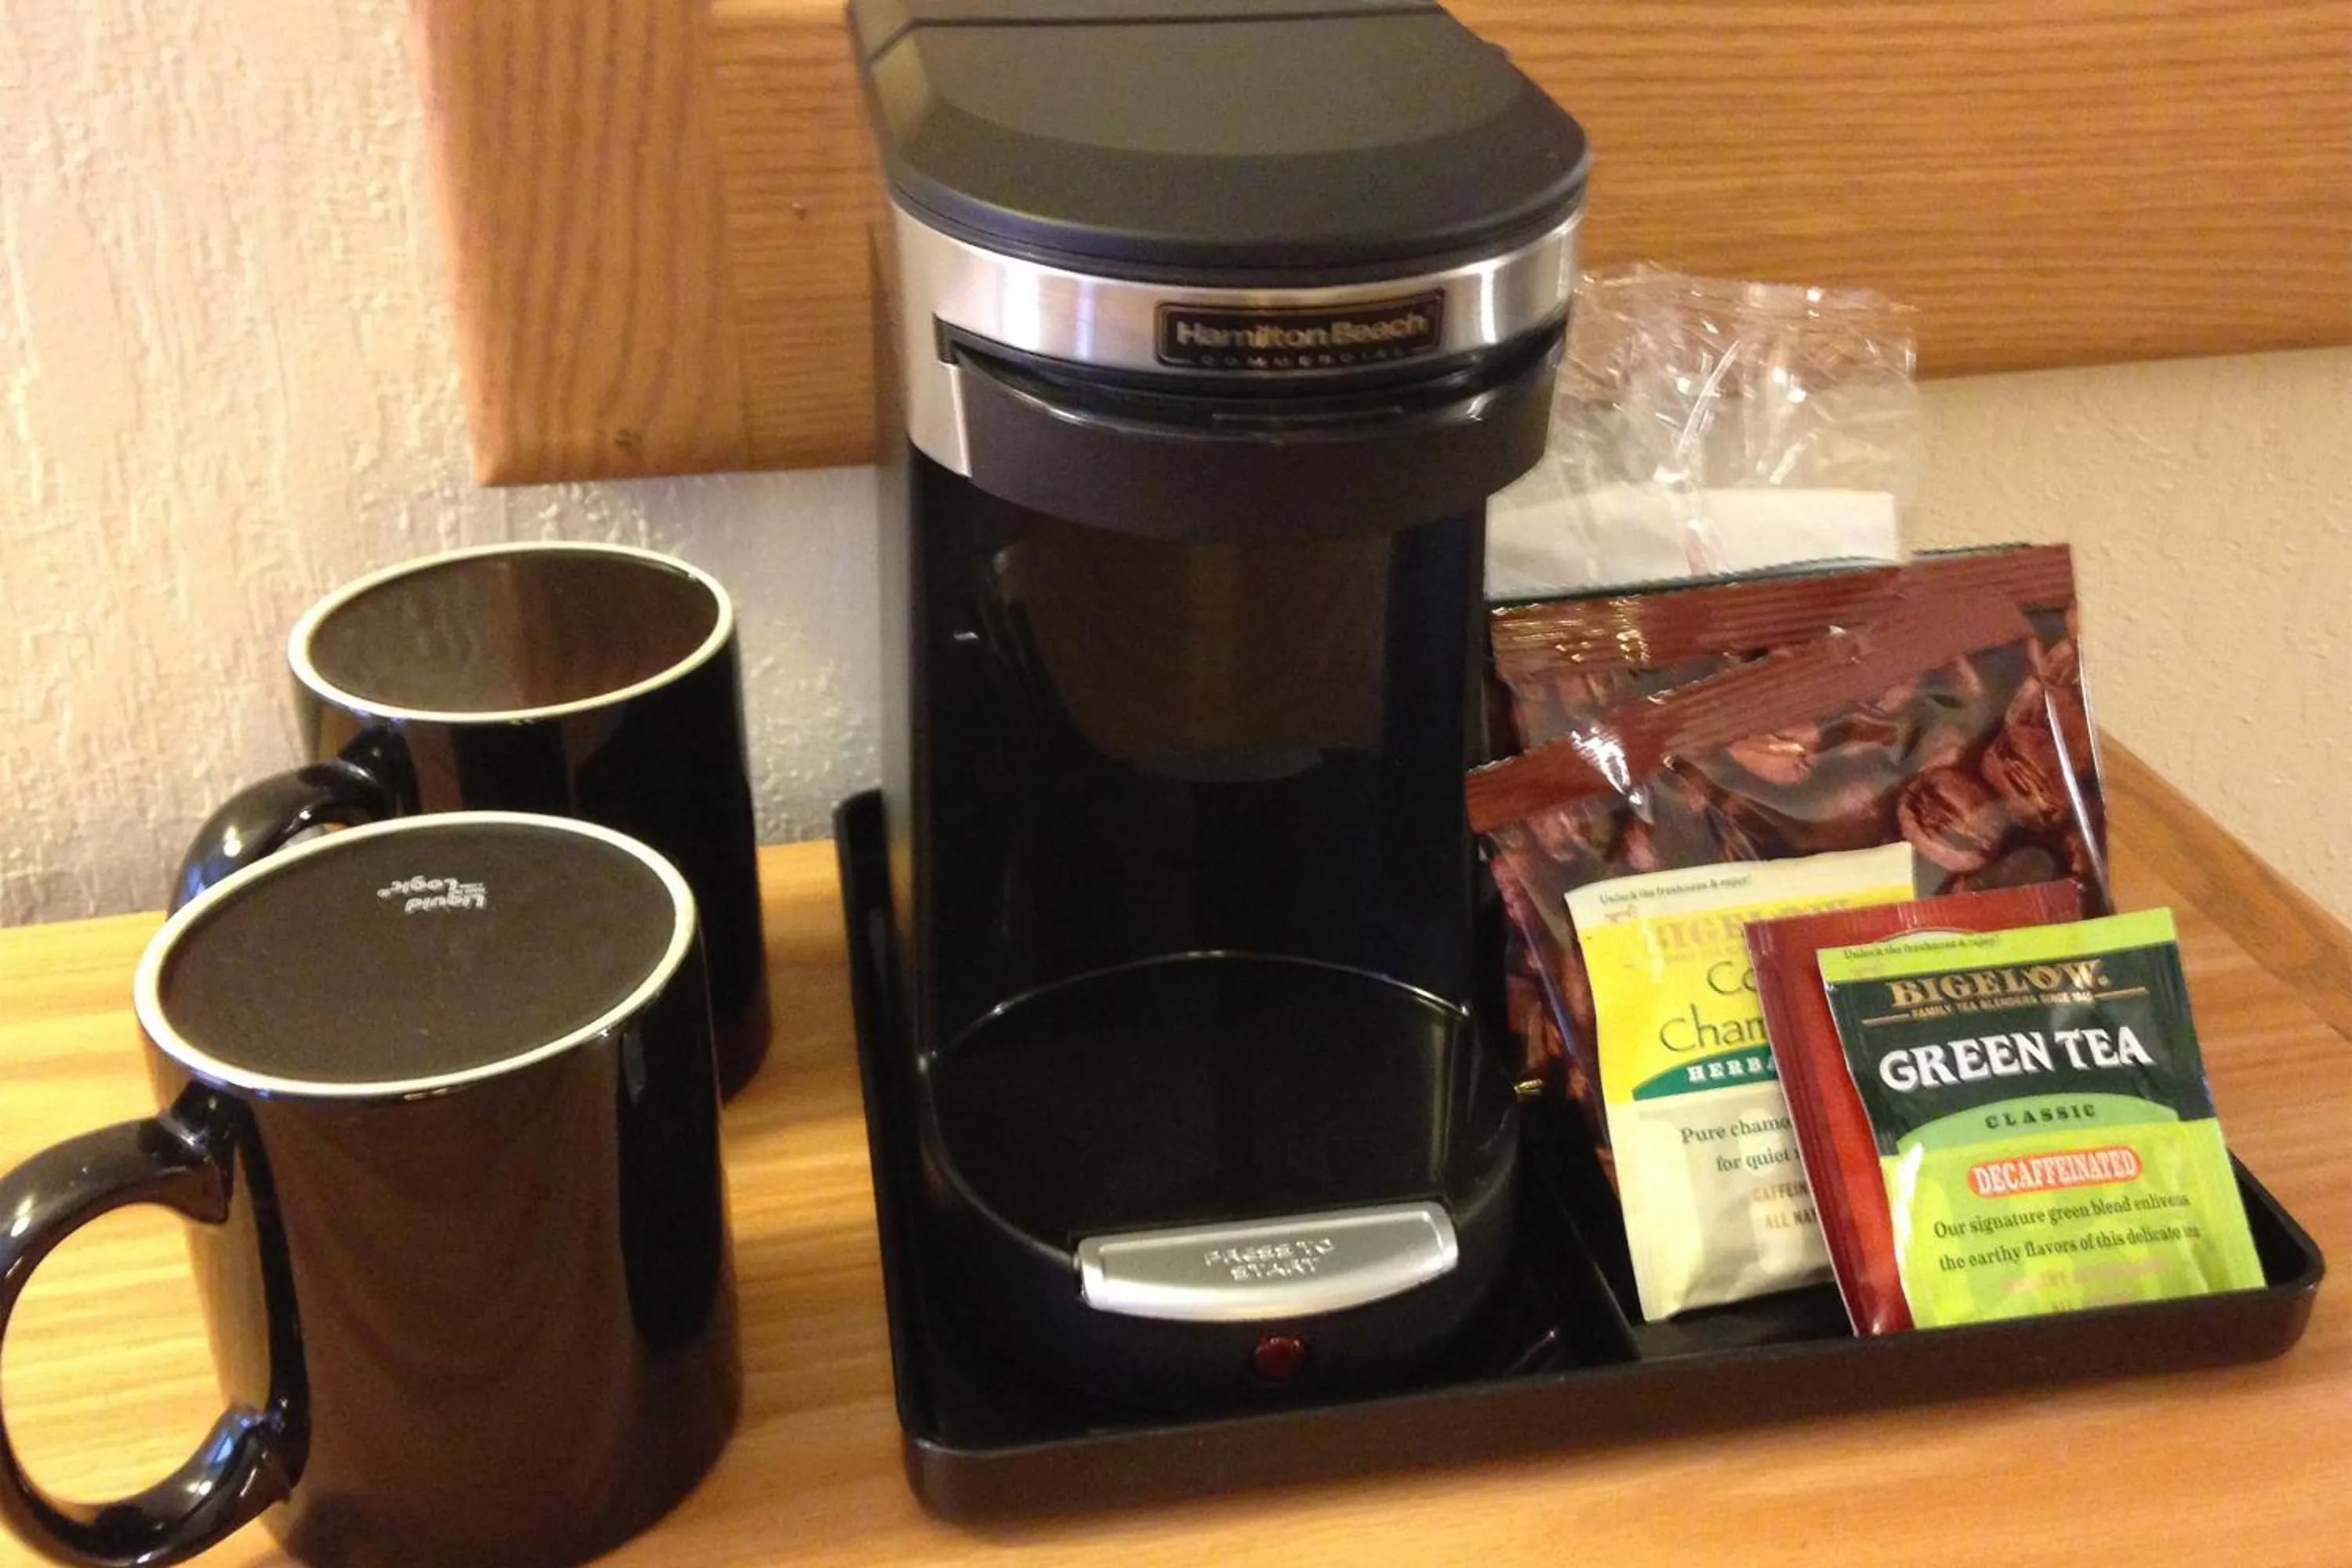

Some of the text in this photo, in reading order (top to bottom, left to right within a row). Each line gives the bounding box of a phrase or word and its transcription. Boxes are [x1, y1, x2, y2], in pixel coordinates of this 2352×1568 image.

[1177, 312, 1430, 349] Hamilton Beach
[390, 875, 459, 895] Logic
[404, 892, 487, 915] Liquid
[1706, 960, 1757, 996] Co
[1886, 958, 2106, 1009] BIGELOW
[1659, 1003, 1766, 1052] Cham
[1879, 1025, 2158, 1094] GREEN TEA
[1680, 1116, 1793, 1145] Pure chamo
[1984, 1103, 2096, 1130] CLASSIC
[1715, 1154, 1742, 1172] for
[1746, 1146, 1791, 1171] quiet
[1973, 1149, 2138, 1196] DECAFFEINATED
[1751, 1179, 1809, 1203] CAFFEIN
[1765, 1213, 1791, 1230] ALL
[1933, 1221, 1969, 1239] Our
[1969, 1207, 2045, 1236] signature
[2046, 1203, 2091, 1226] green
[2090, 1195, 2132, 1216] blend
[1203, 1236, 1336, 1268] PRESS TO
[1939, 1253, 1965, 1272] the
[1969, 1245, 2021, 1267] earthy
[2024, 1240, 2078, 1258] flavors
[2080, 1232, 2094, 1250] of
[2096, 1230, 2126, 1248] this
[2125, 1226, 2181, 1245] delicate
[1230, 1256, 1324, 1281] START
